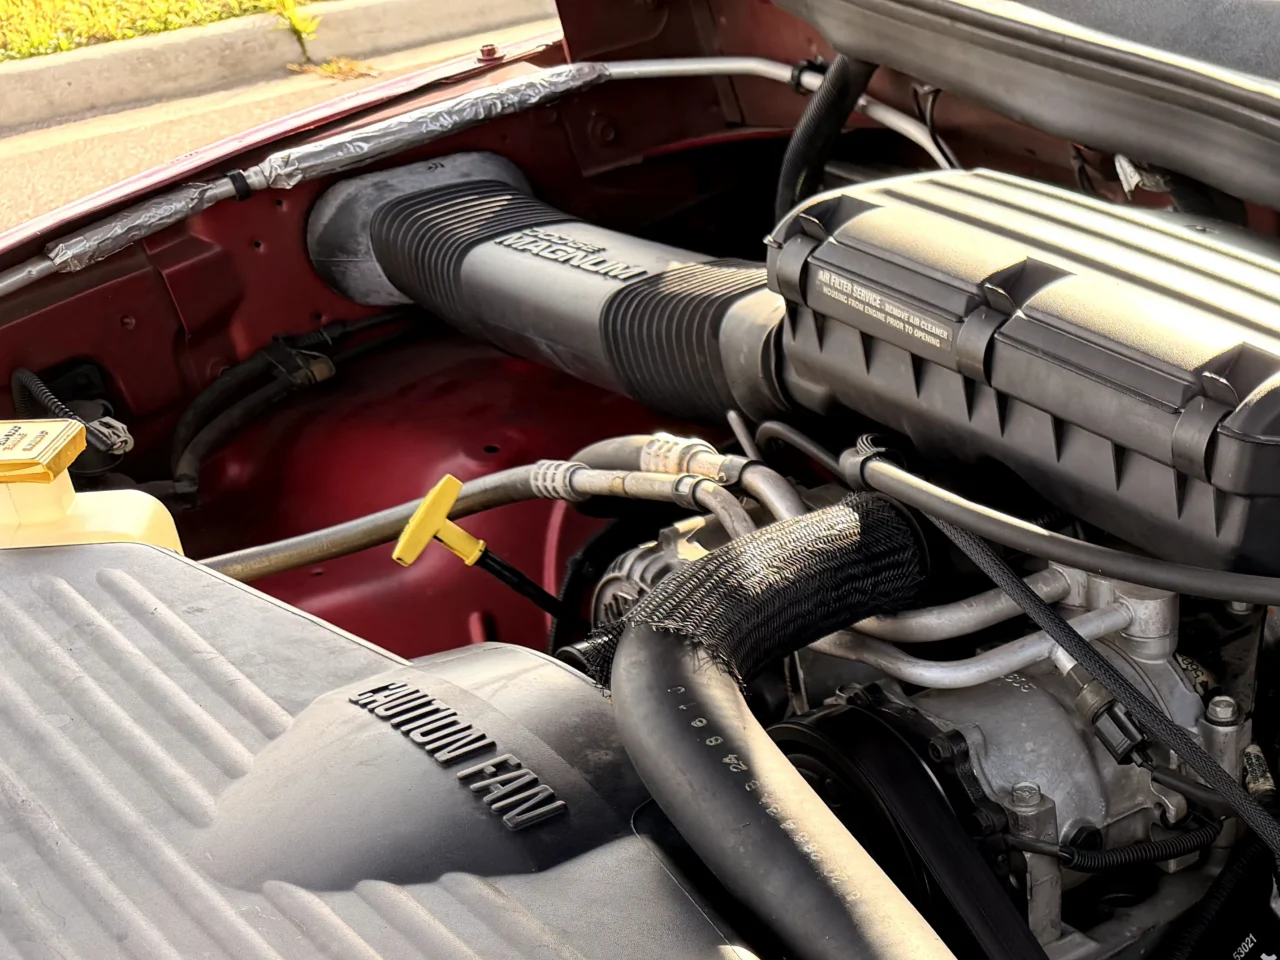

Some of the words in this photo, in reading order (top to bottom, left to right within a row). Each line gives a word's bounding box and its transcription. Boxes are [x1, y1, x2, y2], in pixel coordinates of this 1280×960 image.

[494, 233, 648, 282] MAGNUM
[818, 269, 830, 285] AIR
[830, 273, 852, 294] FILTER
[852, 285, 881, 307] SERVICE
[885, 303, 909, 321] REMOVE
[909, 314, 920, 326] AIR
[920, 320, 948, 340] CLEANER
[823, 286, 848, 305] HOUSING
[848, 298, 864, 312] FROM
[864, 305, 886, 322] ENGINE
[886, 315, 905, 331] PRIOR
[905, 325, 914, 335] TO
[914, 329, 941, 348] OPENING
[348, 682, 497, 763] CAUTION
[457, 753, 568, 832] FAN
